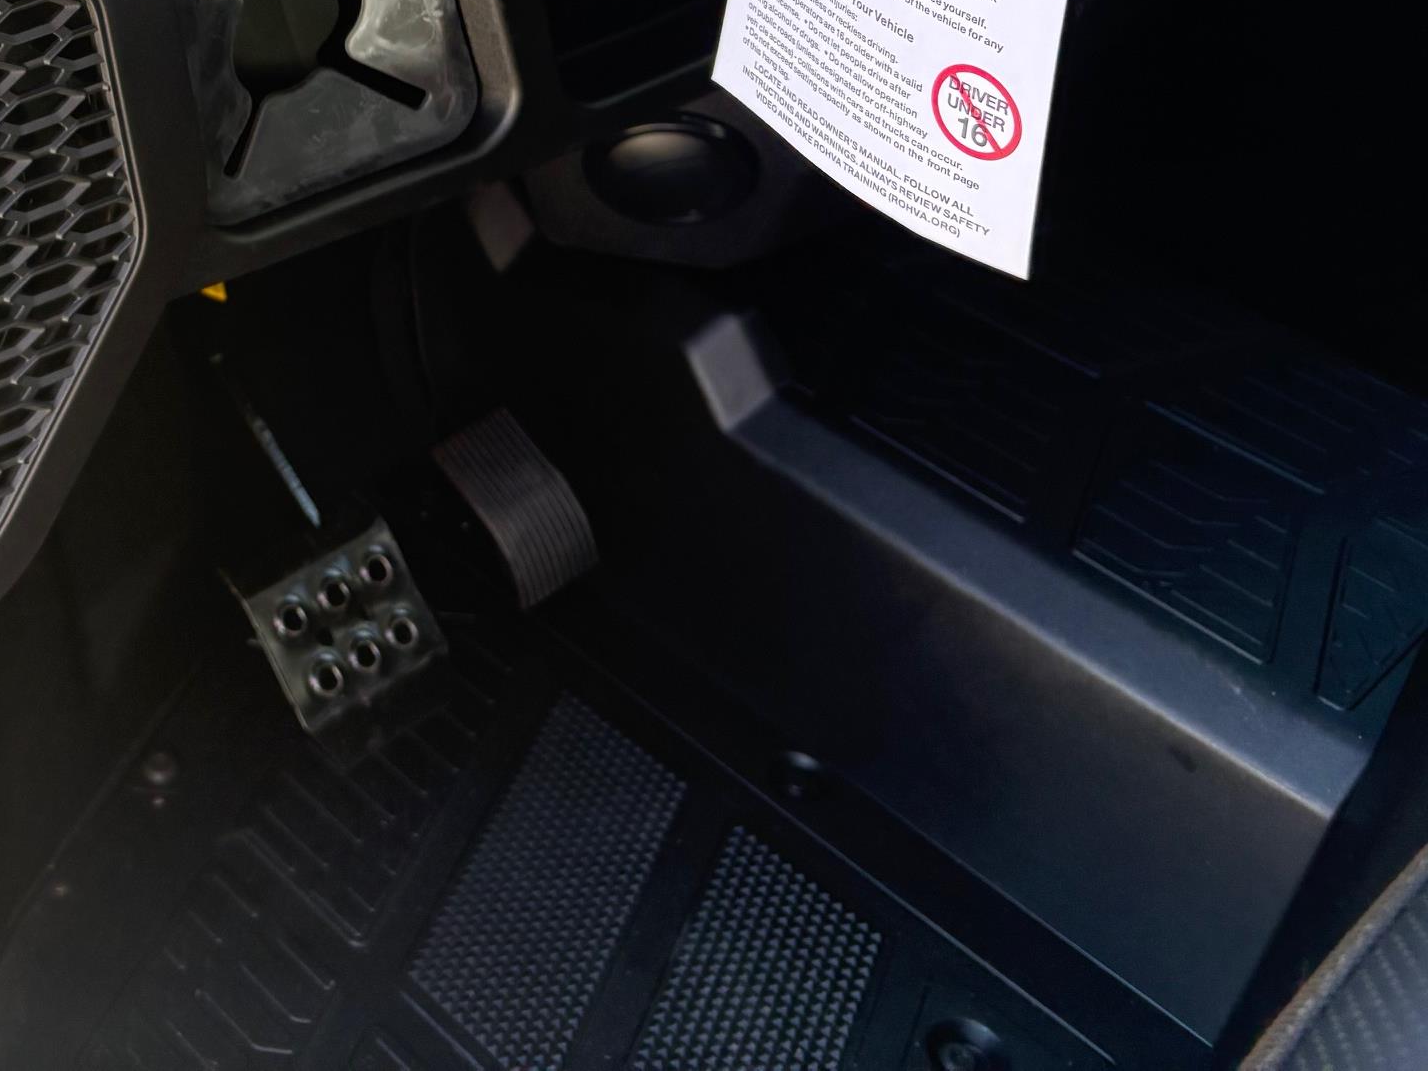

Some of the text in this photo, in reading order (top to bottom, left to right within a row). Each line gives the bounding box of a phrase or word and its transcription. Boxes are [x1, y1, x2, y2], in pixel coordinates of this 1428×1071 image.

[875, 10, 914, 43] Vehicle
[915, 0, 930, 15] the
[932, 11, 966, 34] vehicle
[968, 27, 983, 41] for
[984, 37, 1004, 53] any
[943, 1, 986, 29] yourself.
[947, 93, 1006, 133] UNDER
[948, 75, 1009, 115] DRIVER
[874, 102, 928, 139] off-highway
[958, 117, 988, 147] 16
[882, 119, 962, 171] trucks can occur.
[812, 125, 989, 235] WARNINGS. ALWAYS REVIEW SAFETY
[819, 117, 973, 217] OWNER'S MANUAL. FOLLOW ALL
[927, 158, 979, 190] front page
[840, 161, 960, 237] TRAINING (ROHVA.ORG)
